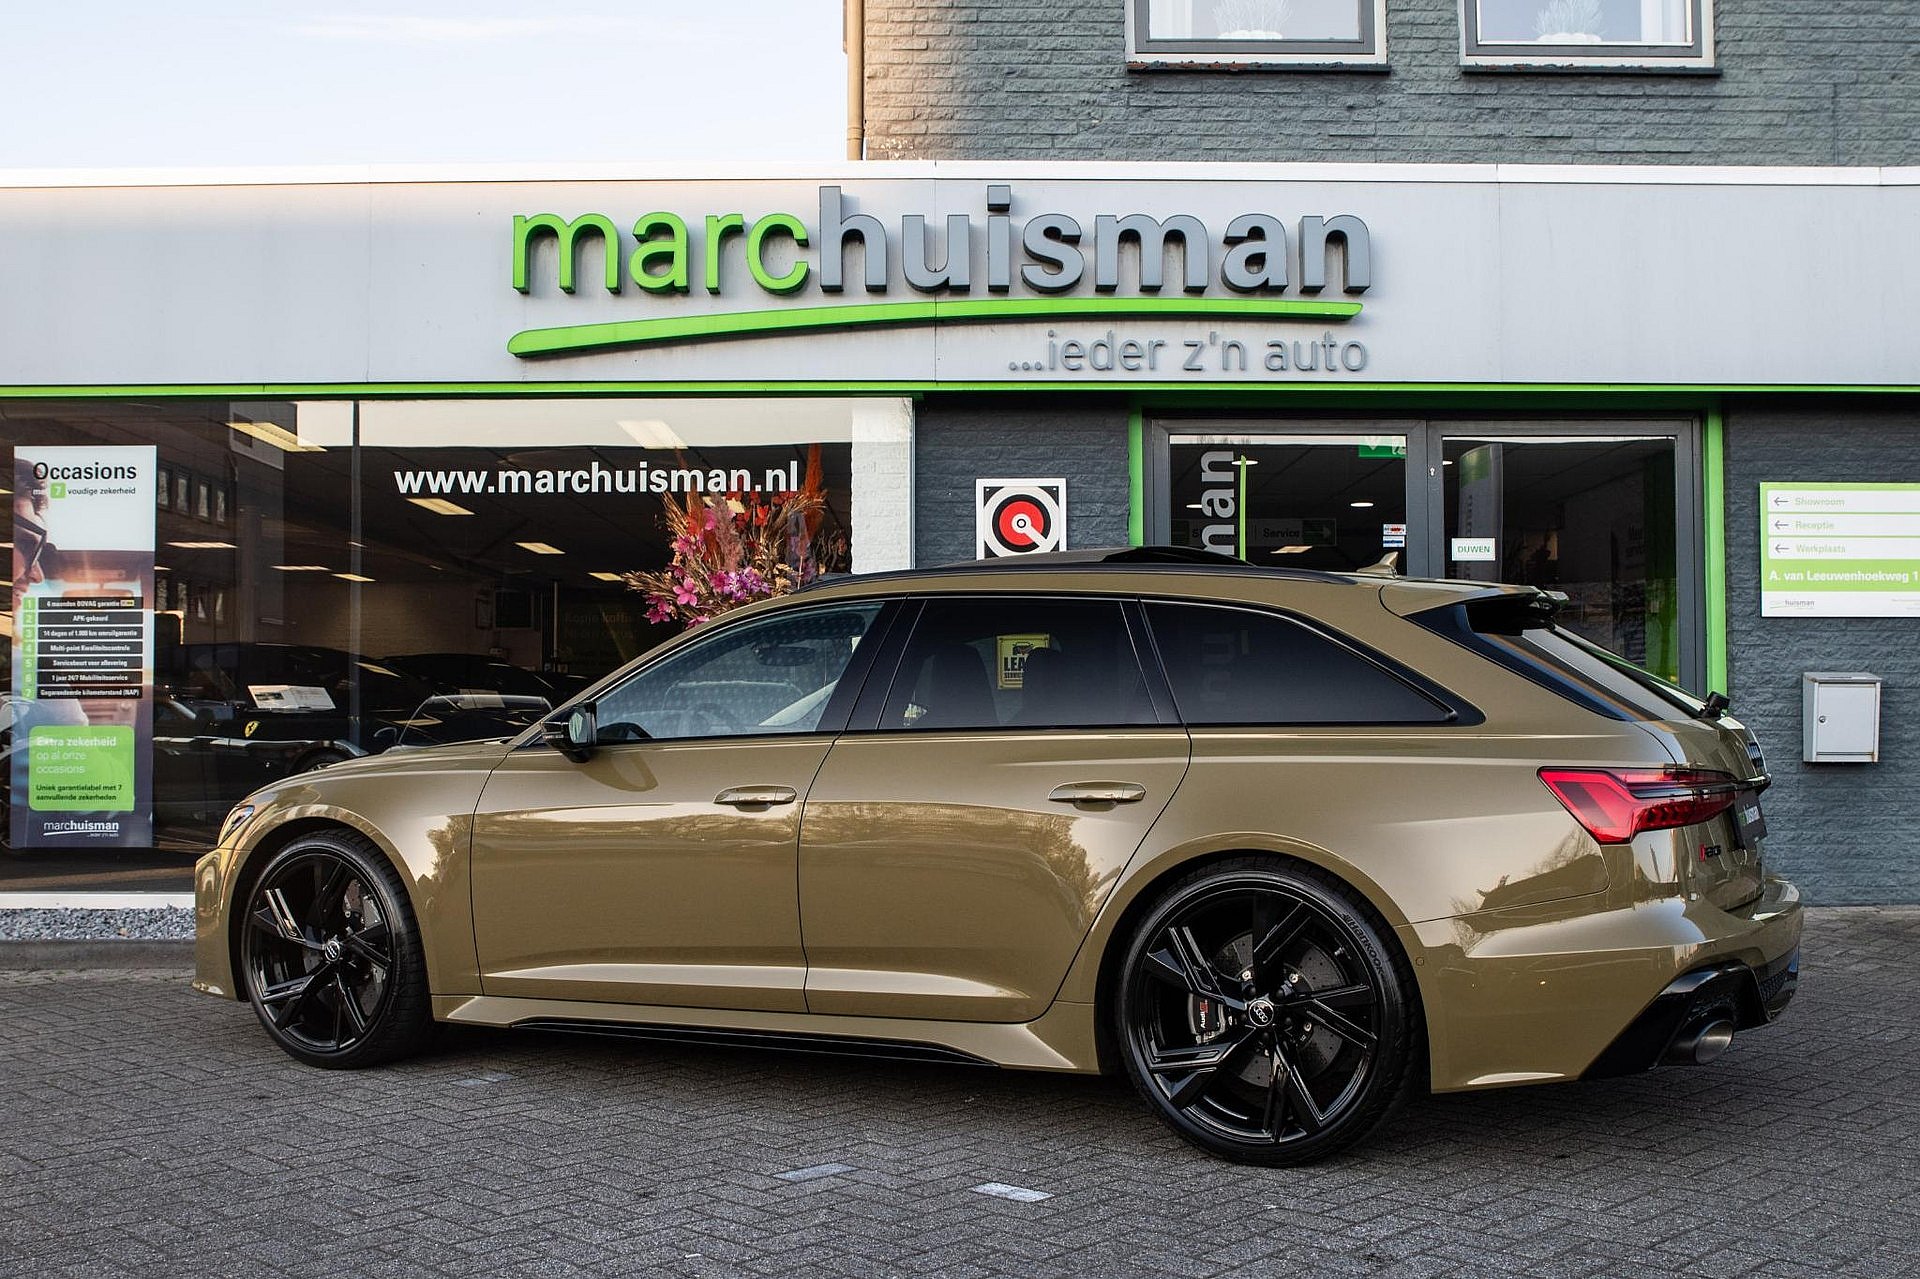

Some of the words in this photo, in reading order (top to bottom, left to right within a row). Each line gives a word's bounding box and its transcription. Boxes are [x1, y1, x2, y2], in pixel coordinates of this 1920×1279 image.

[513, 185, 1371, 294] marchuisman
[1008, 328, 1166, 372] ...ieder
[1183, 331, 1246, 372] z'n
[1264, 331, 1367, 372] auto
[33, 461, 137, 480] Occasions
[394, 461, 799, 494] www.marchuisman.nl
[67, 487, 98, 496] voudige
[99, 487, 136, 495] zekerheid
[1795, 497, 1845, 507] Showroom
[1795, 520, 1834, 531] Receptie
[1263, 527, 1300, 538] Service
[1457, 545, 1491, 554] DUWEN
[1796, 544, 1846, 555] Werkplaats
[1768, 570, 1781, 581] A.
[1784, 571, 1804, 582] van
[1806, 570, 1909, 584] Leeuwenhoekweg
[51, 630, 67, 638] dagen
[101, 660, 128, 668] aflevering
[66, 736, 117, 747] zekerheid
[36, 752, 49, 762] op
[62, 752, 88, 761] onze
[36, 765, 86, 774] occasions
[57, 784, 102, 793] garantielabel
[43, 819, 120, 831] marchuisman
